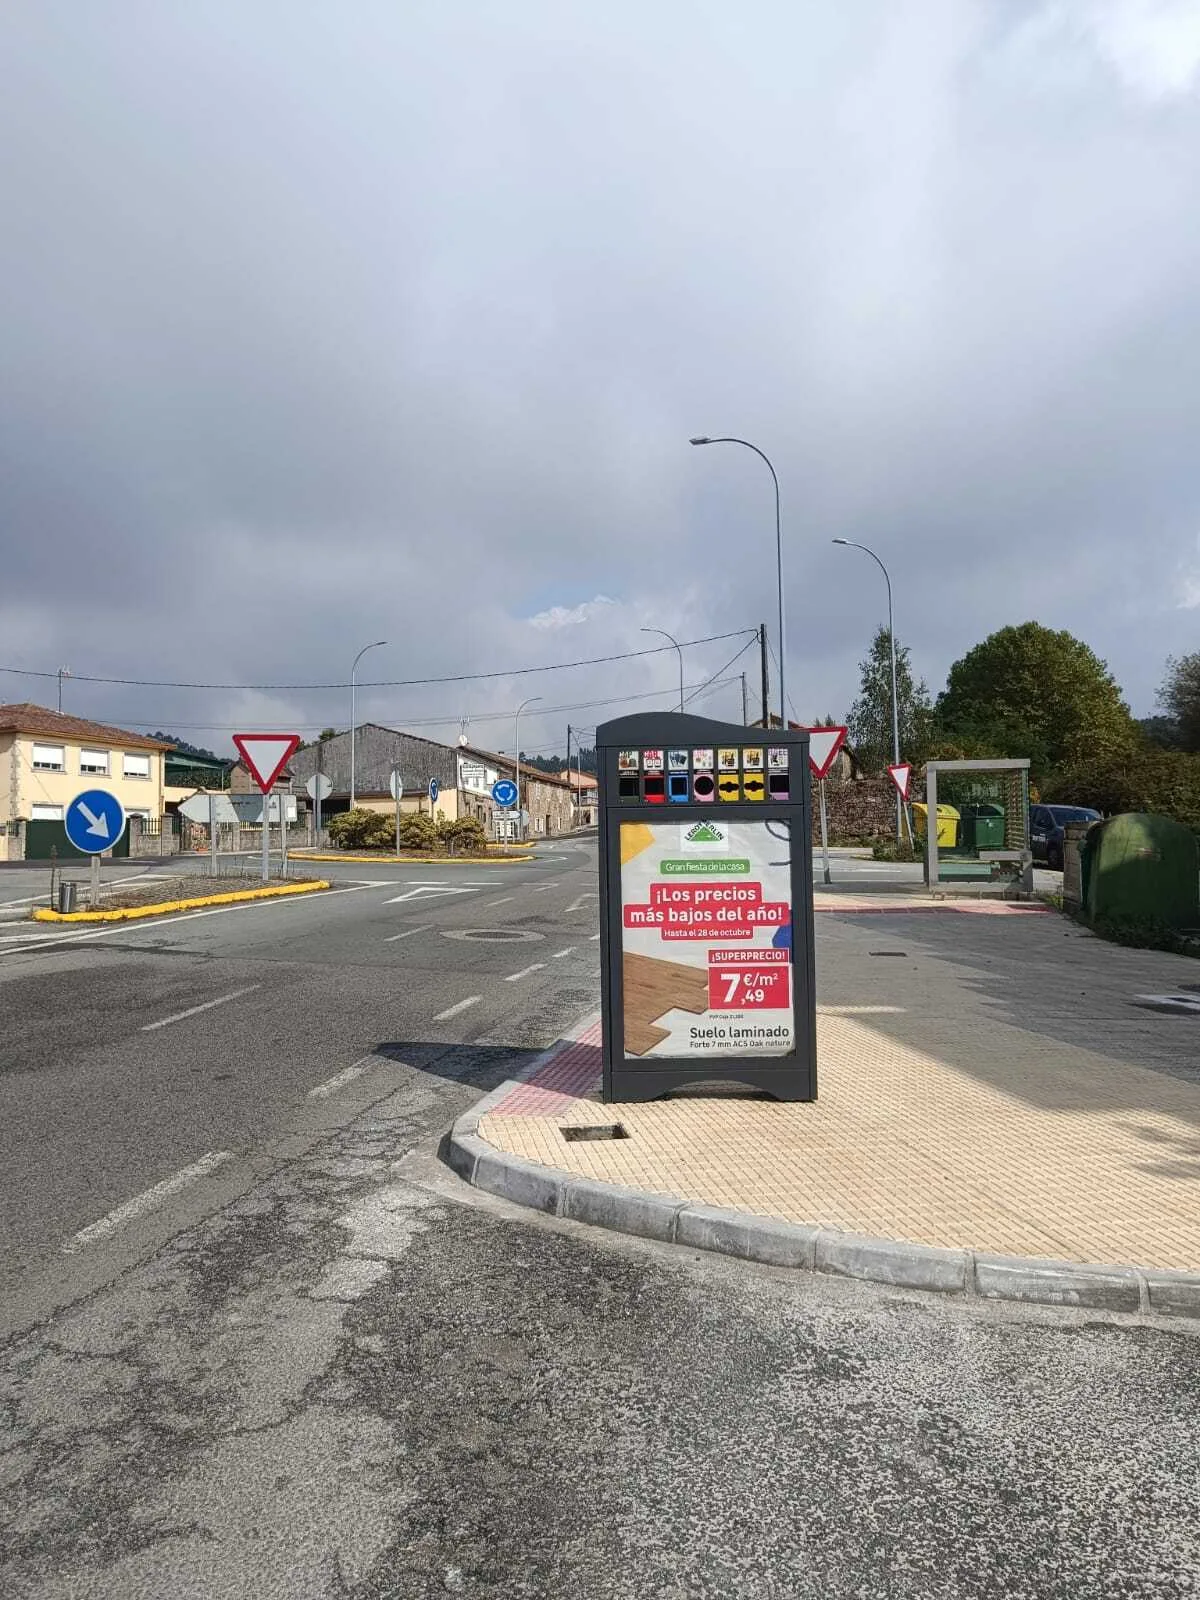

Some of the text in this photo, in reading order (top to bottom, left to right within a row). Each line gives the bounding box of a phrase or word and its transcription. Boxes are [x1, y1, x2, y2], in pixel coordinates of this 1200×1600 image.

[666, 863, 685, 871] Gran
[686, 862, 707, 871] fiesta
[708, 862, 718, 871] de
[727, 863, 745, 871] casa
[656, 887, 756, 905] ¡Los precios
[631, 906, 783, 925] más bajos del año!
[664, 928, 751, 937] Hasta el 28 de octubre
[711, 952, 785, 962] ¡SUPERPRECIO!
[720, 973, 740, 1003] 7
[690, 1026, 789, 1038] Suelo laminado
